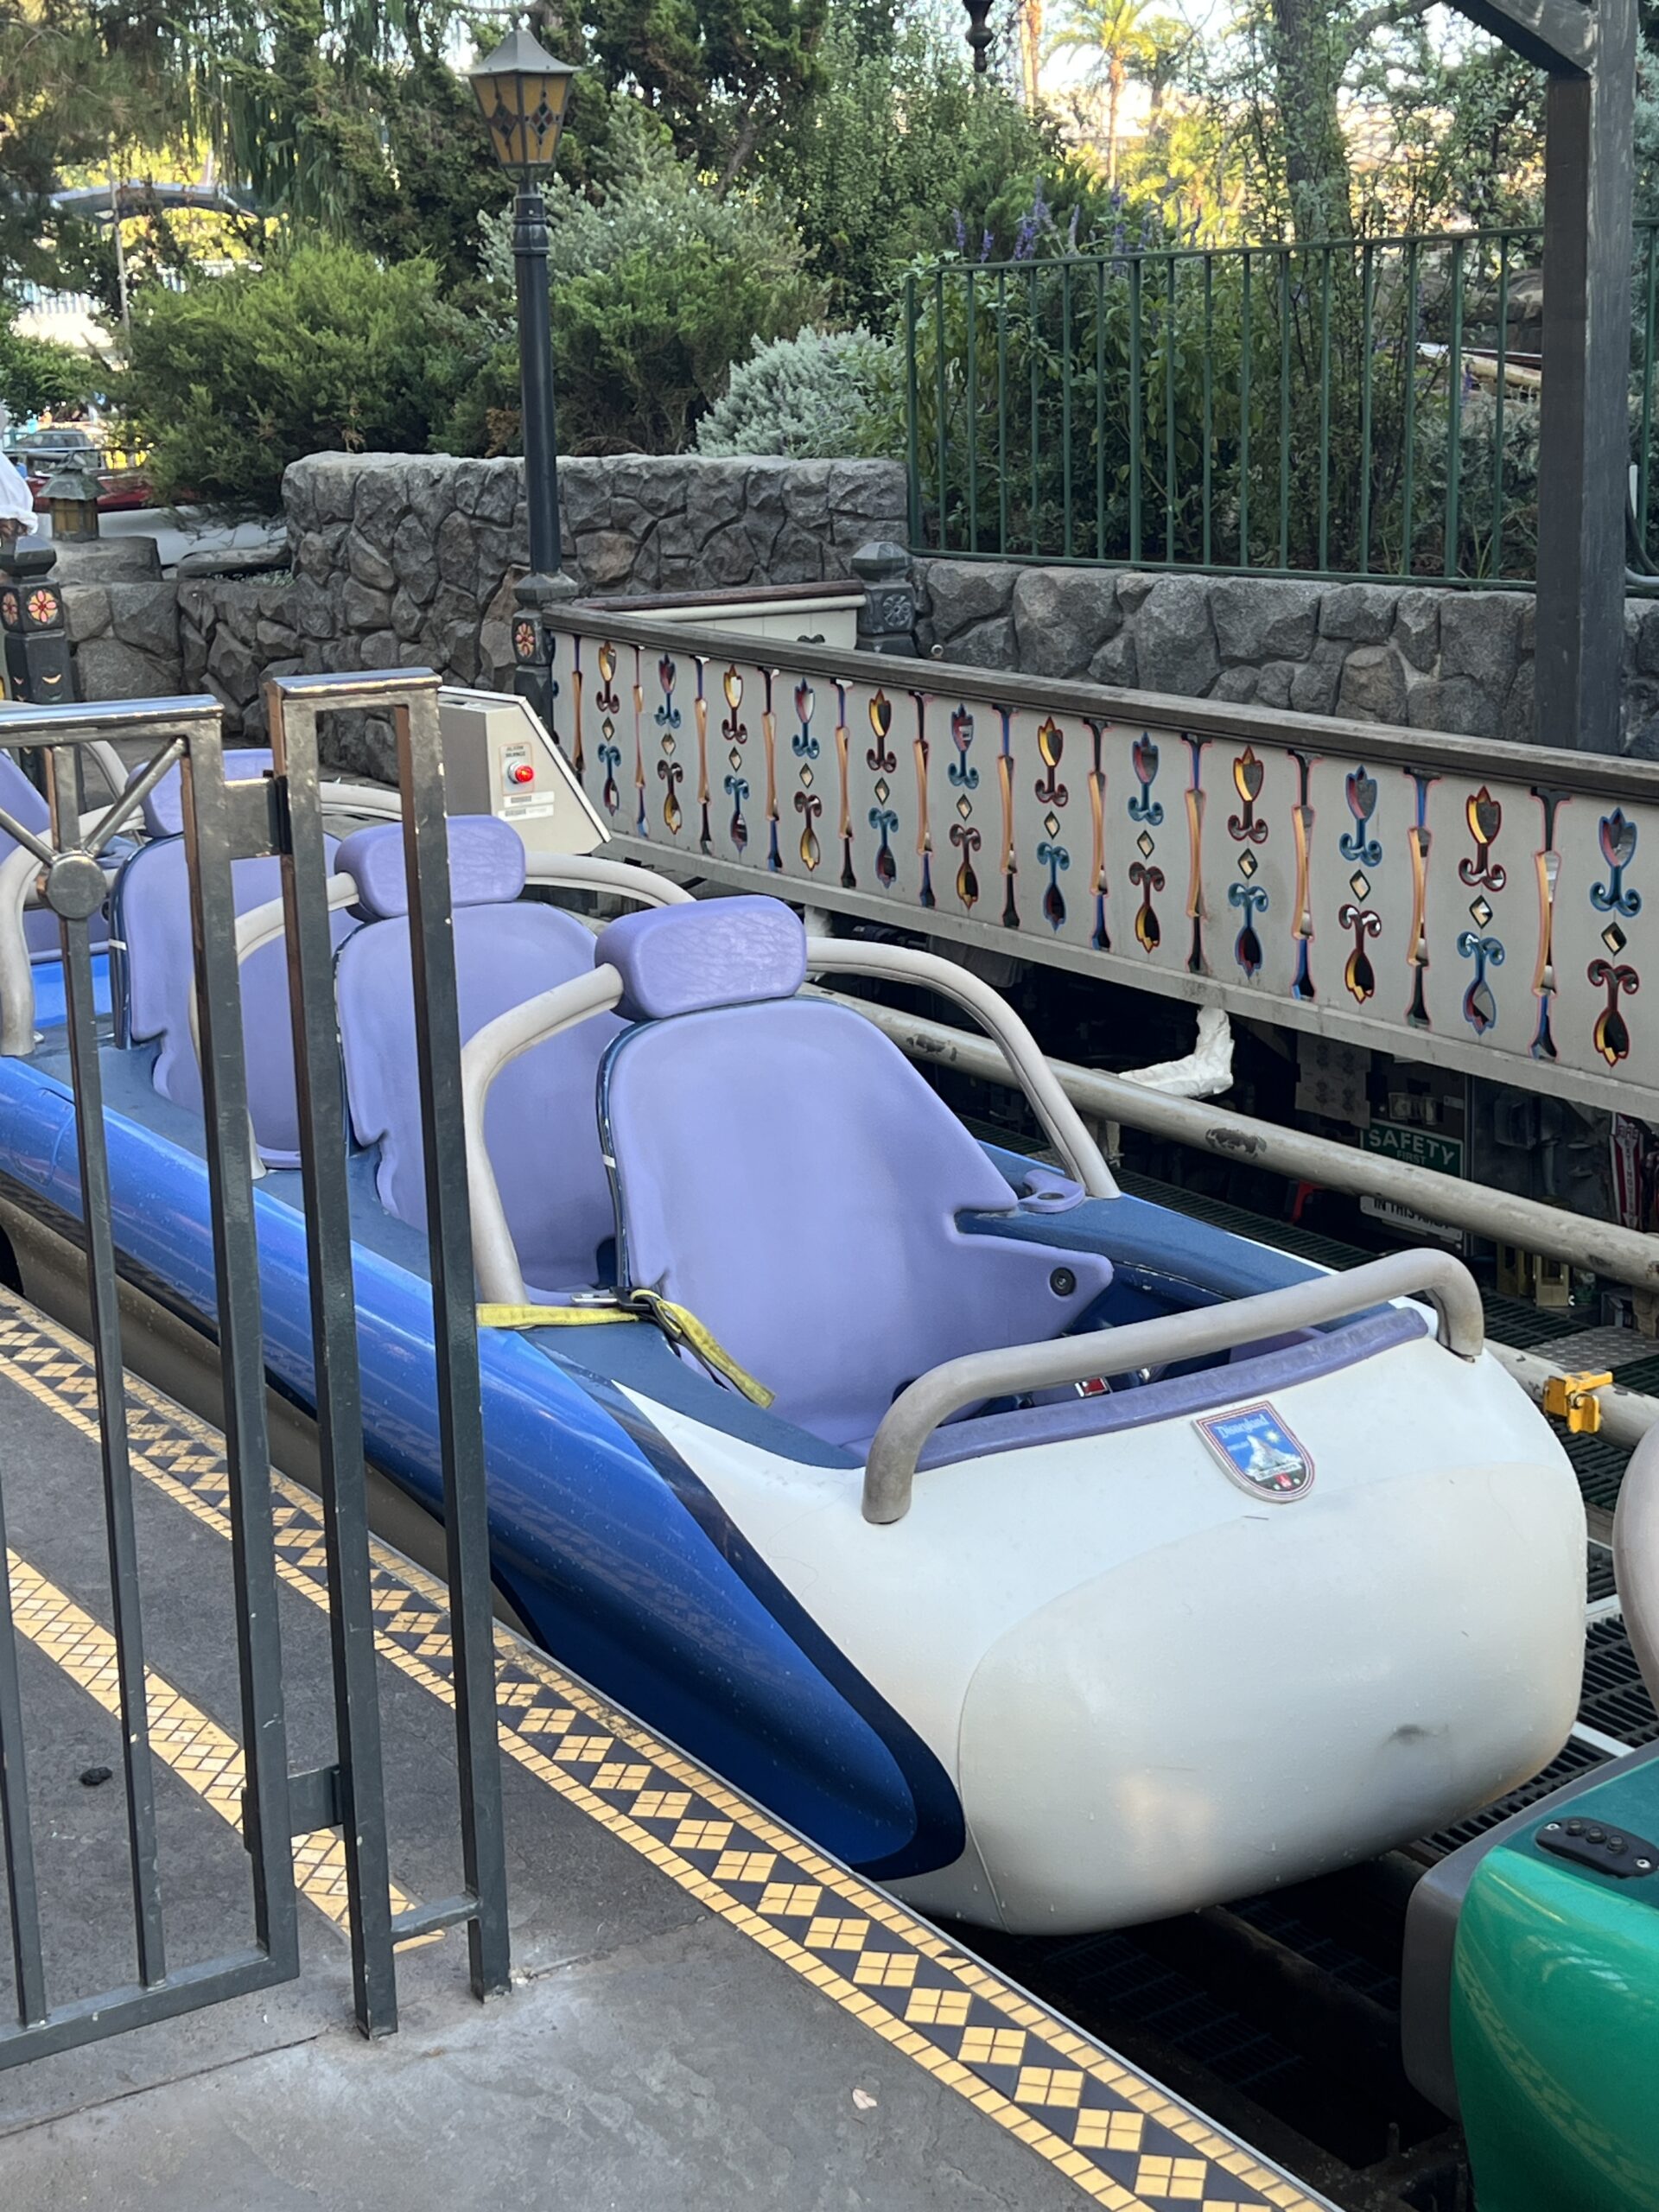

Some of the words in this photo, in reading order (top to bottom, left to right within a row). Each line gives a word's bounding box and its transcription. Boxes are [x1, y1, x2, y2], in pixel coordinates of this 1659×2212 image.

[1369, 1128, 1455, 1166] SAFETY
[1396, 1149, 1427, 1166] FIRST
[1215, 1413, 1269, 1439] Disneyland
